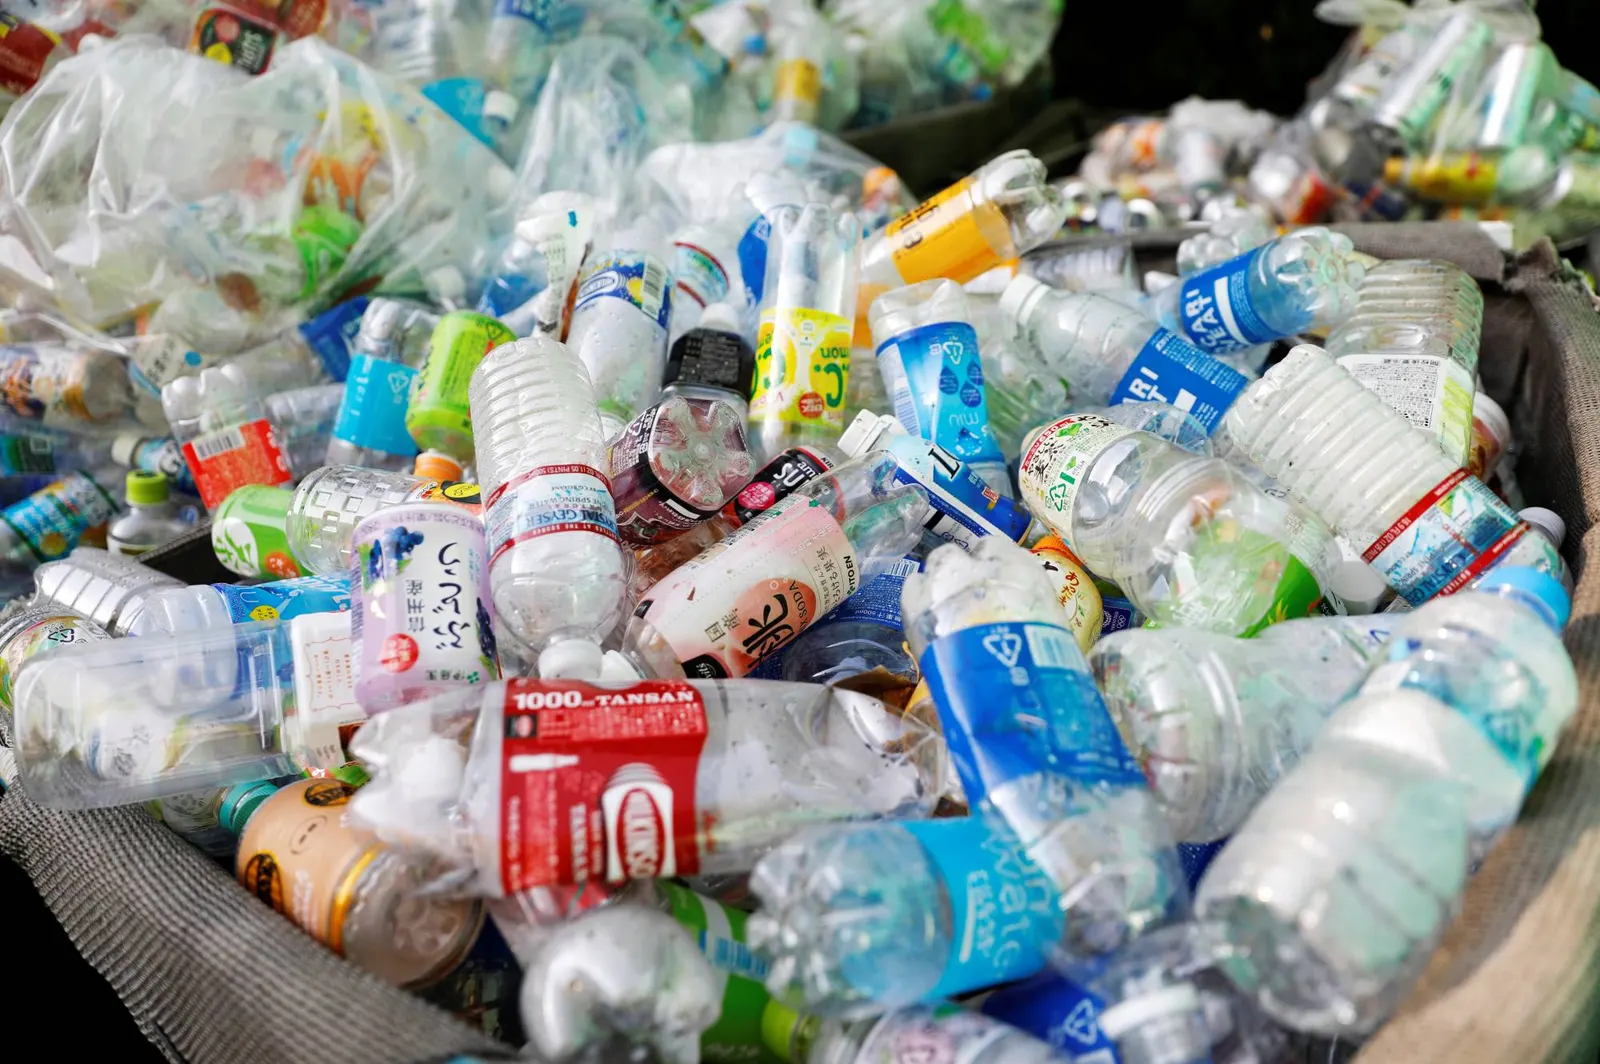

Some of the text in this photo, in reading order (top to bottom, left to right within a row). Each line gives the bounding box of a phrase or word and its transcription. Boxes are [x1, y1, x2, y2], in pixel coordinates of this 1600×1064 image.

[432, 542, 471, 650] ぶどう
[594, 690, 694, 707] TANSAN
